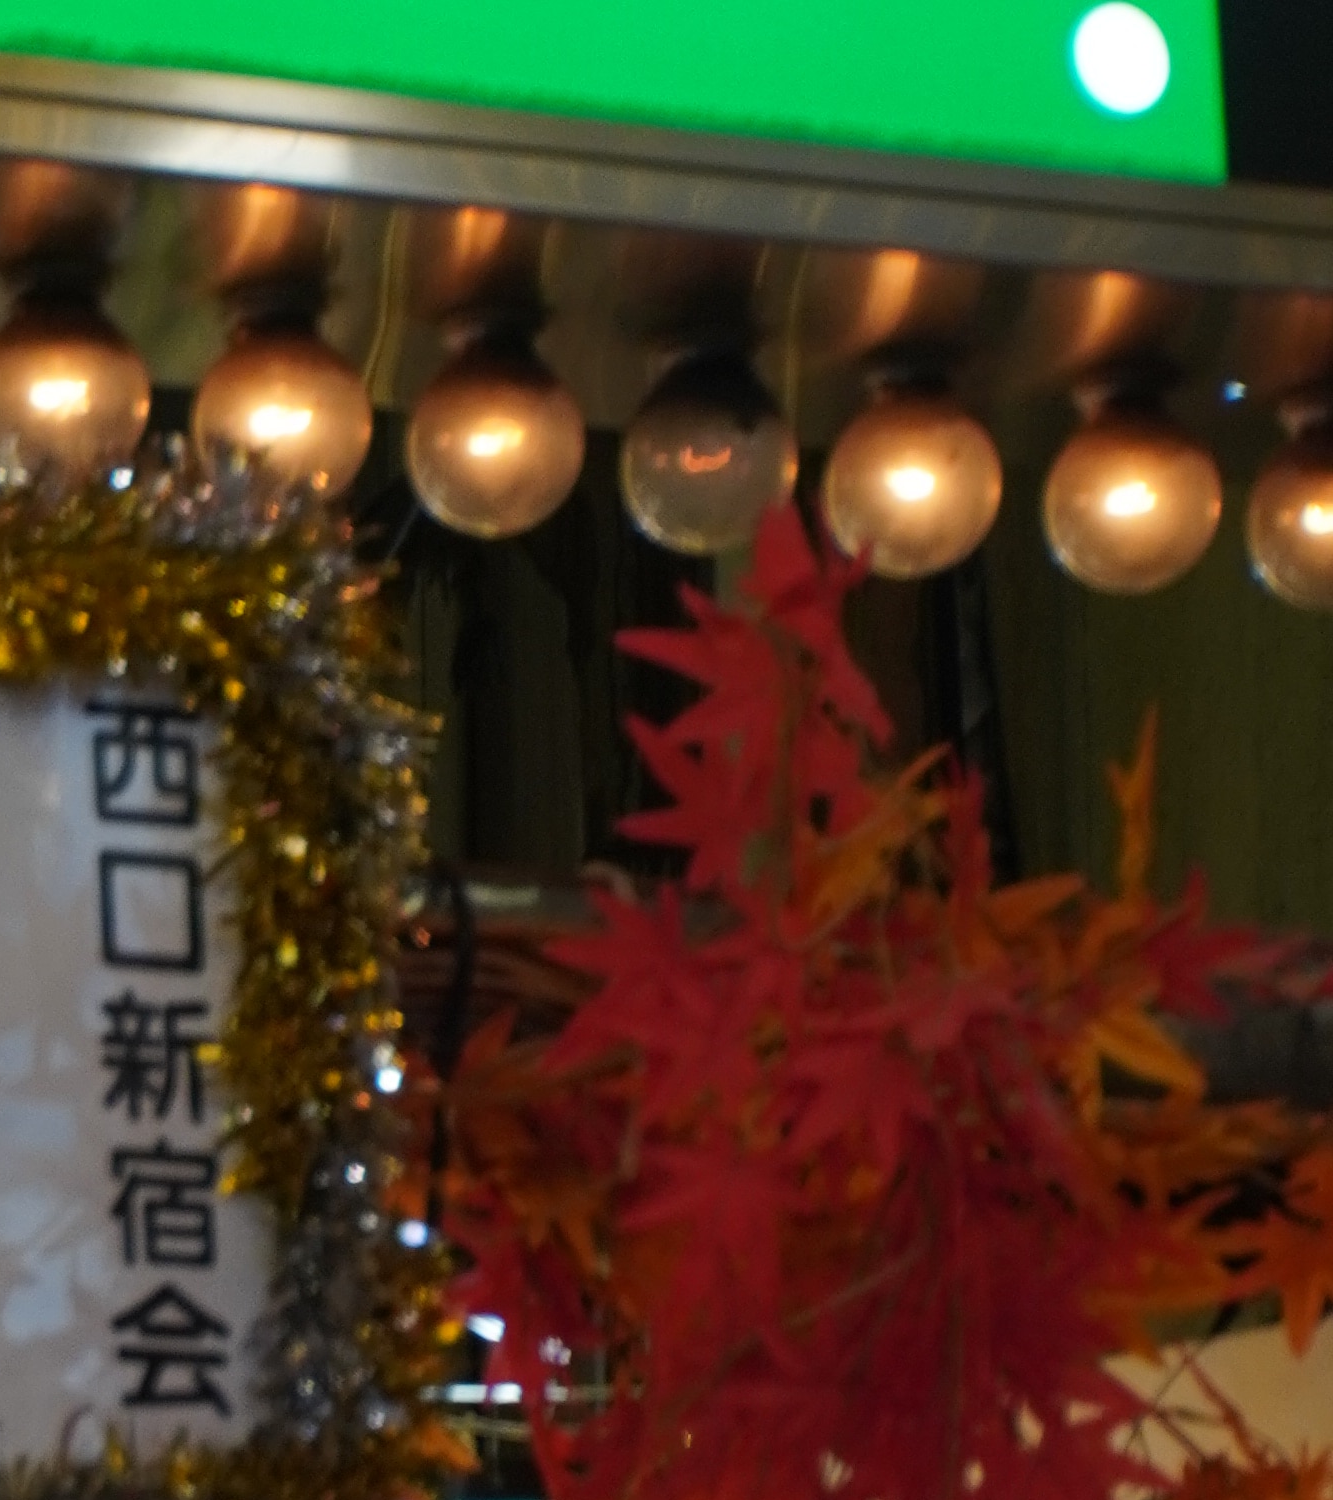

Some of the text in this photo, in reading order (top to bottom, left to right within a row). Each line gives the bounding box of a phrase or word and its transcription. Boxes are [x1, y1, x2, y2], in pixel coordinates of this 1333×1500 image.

[83, 699, 232, 1420] 西口新宿会
